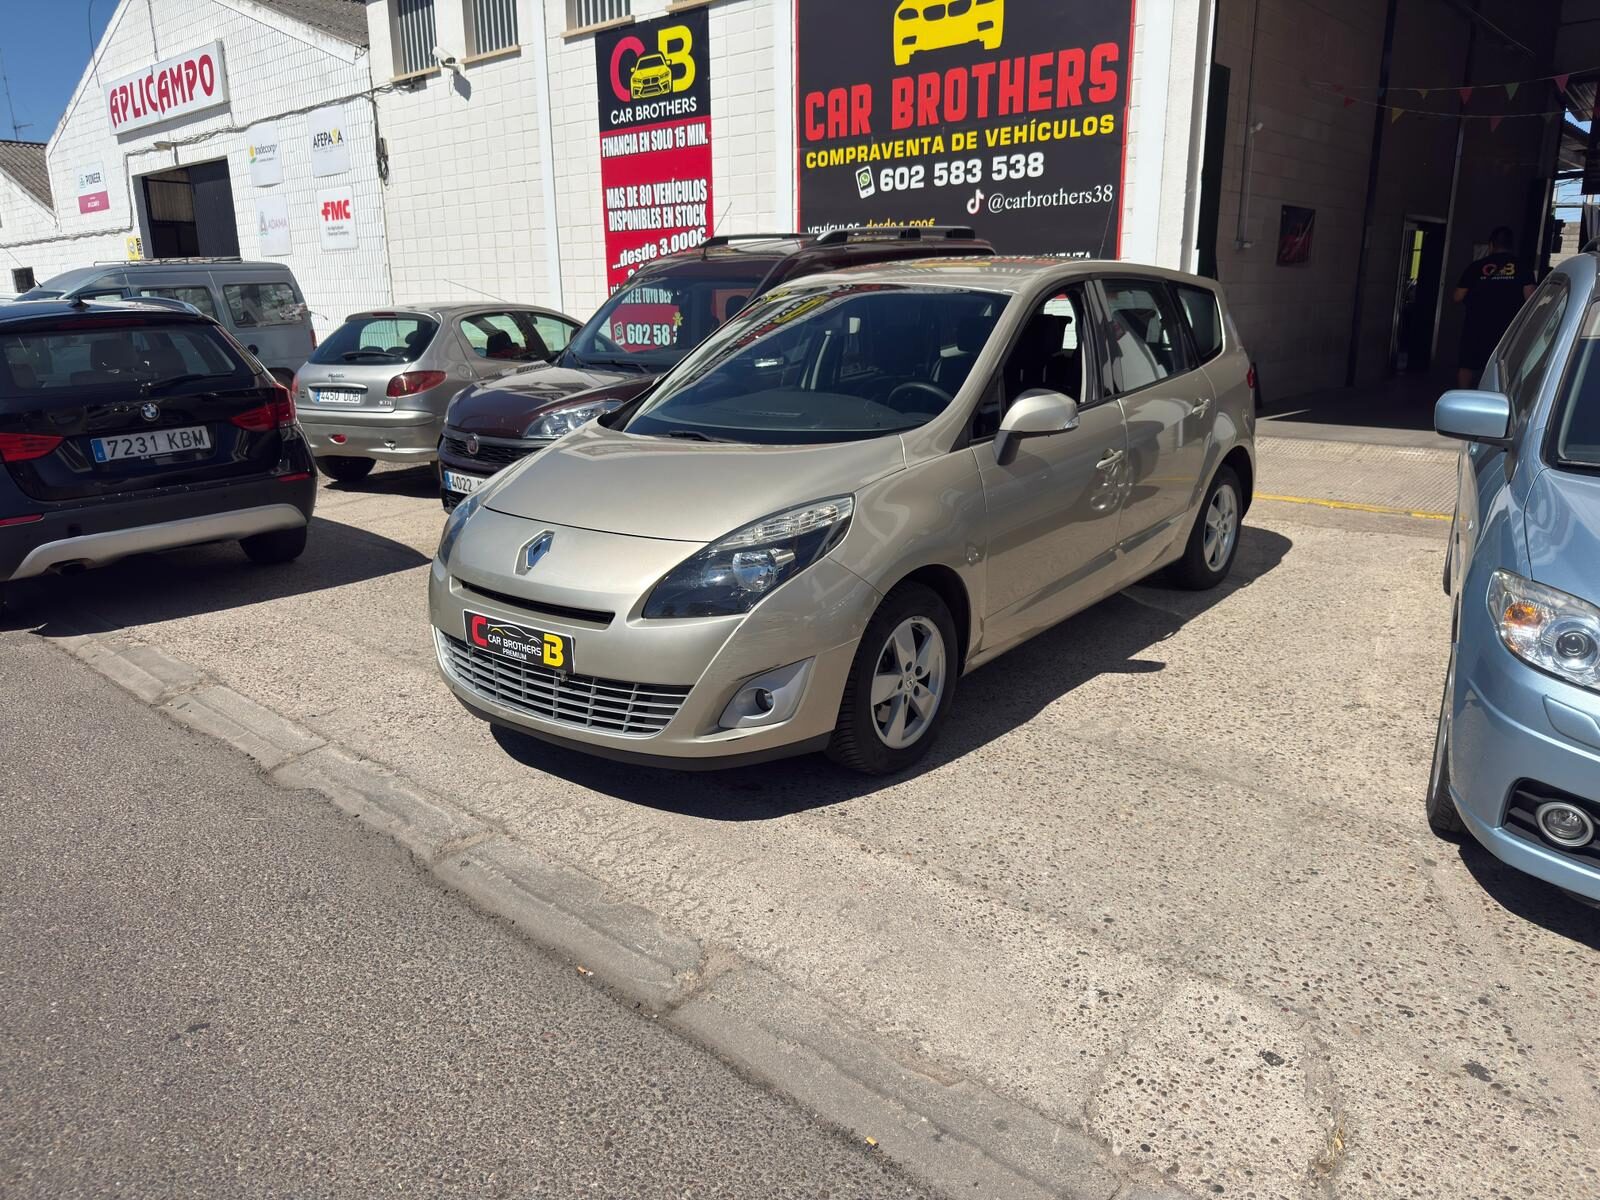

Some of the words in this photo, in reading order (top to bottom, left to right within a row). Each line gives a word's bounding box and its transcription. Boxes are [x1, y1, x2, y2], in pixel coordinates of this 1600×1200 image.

[109, 54, 215, 129] APLICAMPO
[805, 83, 873, 142] CAR
[891, 42, 1119, 130] BROTHERS
[610, 107, 634, 125] CAR
[636, 97, 697, 121] BROTHERS
[601, 134, 638, 158] FINANCIA
[639, 131, 650, 153] EN
[651, 128, 673, 151] SOLO
[674, 126, 686, 148] 15
[687, 123, 709, 146] MIN.
[806, 136, 944, 169] COMPRAVENTA
[951, 131, 978, 152] DE
[985, 114, 1115, 147] VEHÍCULOS
[879, 168, 925, 192] 602
[933, 158, 982, 187] 583
[991, 152, 1045, 180] 538
[606, 185, 625, 210] MAS
[626, 184, 639, 207] DE
[639, 184, 651, 206] 80
[653, 178, 708, 205] VEHÍCULOS
[987, 184, 1114, 214] @carbrothers38
[321, 200, 351, 222] FMC
[608, 207, 662, 232] DISPONIBLES
[662, 206, 674, 228] EN
[675, 203, 707, 228] STOCK
[659, 227, 707, 257] 3.000€
[626, 323, 651, 346] 602
[106, 436, 160, 458] 7231
[167, 429, 207, 450] KBM
[452, 476, 472, 493] 4022
[488, 634, 501, 646] CAR
[503, 638, 542, 657] BROTHERS
[502, 648, 527, 661] PREMIUM
